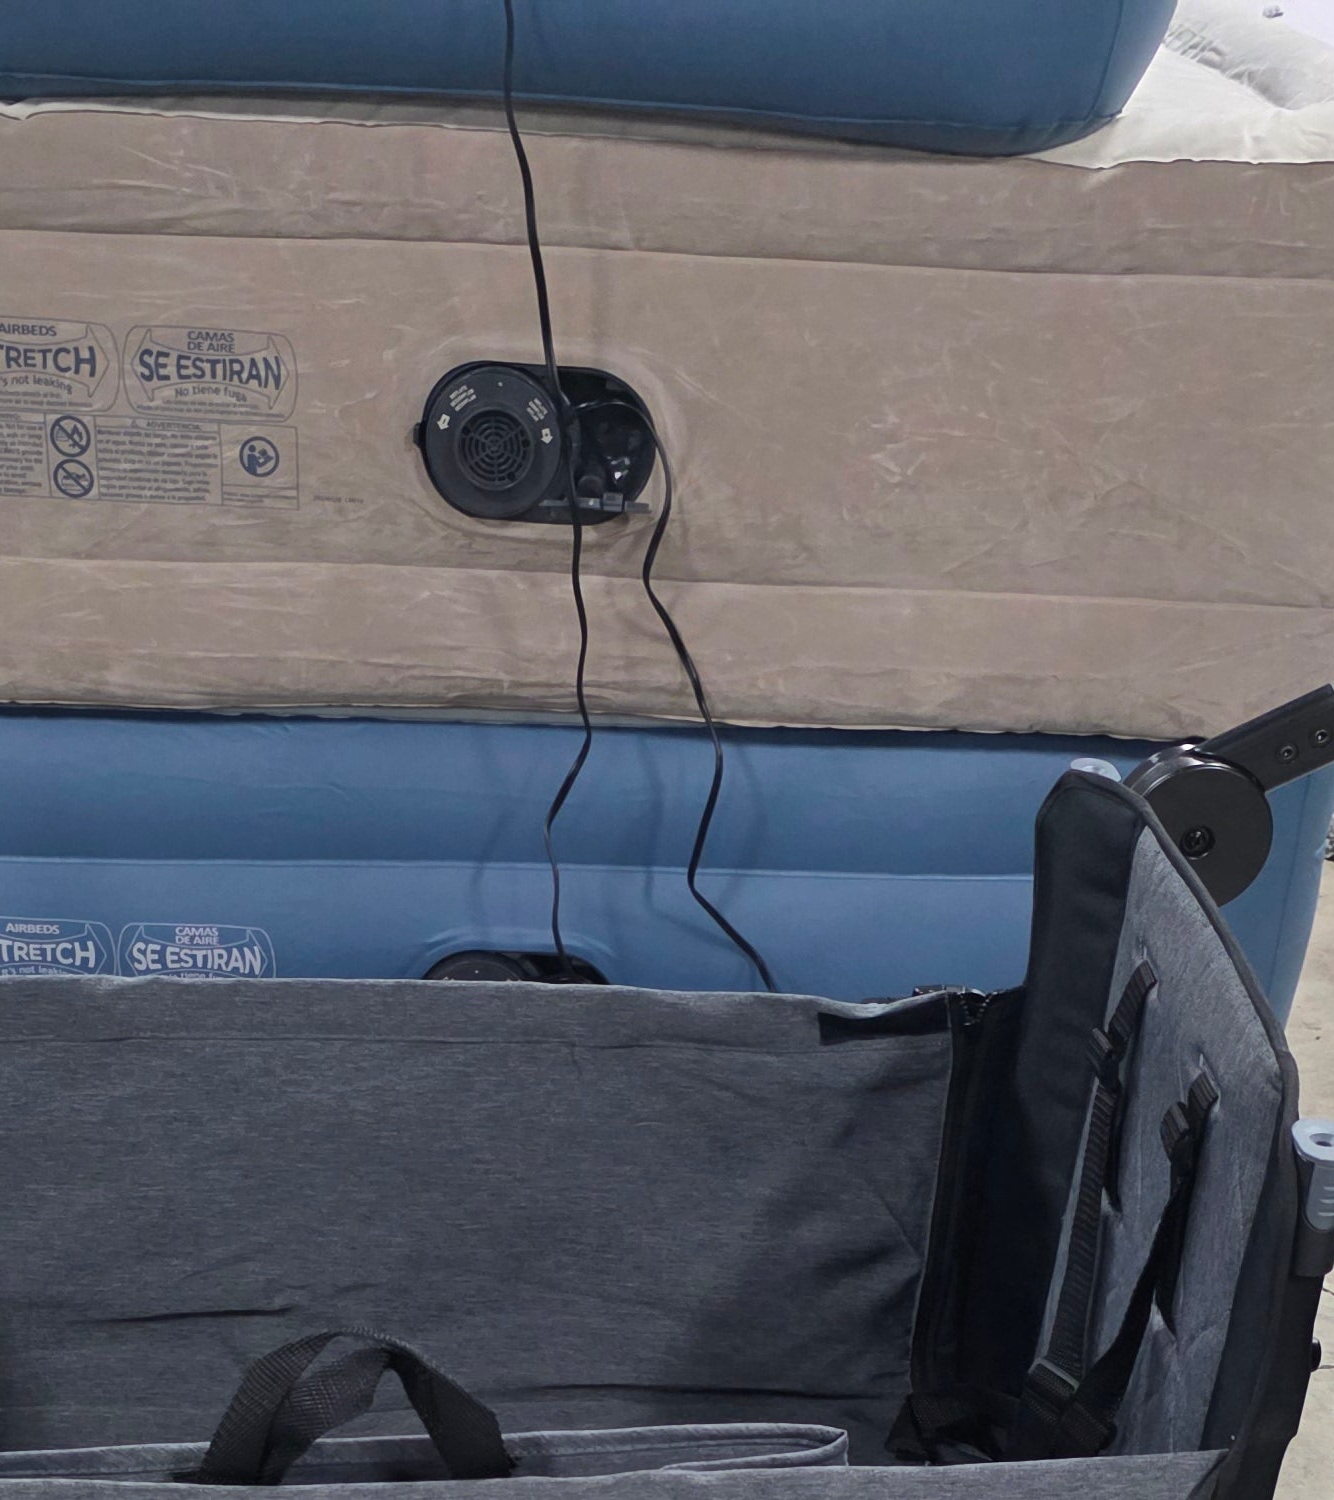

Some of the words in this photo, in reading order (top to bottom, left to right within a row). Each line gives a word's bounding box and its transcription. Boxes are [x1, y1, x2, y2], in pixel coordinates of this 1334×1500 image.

[187, 330, 235, 342] CAMAS
[187, 341, 203, 351] DE
[207, 343, 235, 353] AIRE
[139, 349, 170, 382] SE
[176, 354, 281, 390] ESTIRAN
[11, 375, 30, 385] not
[33, 375, 73, 395] leaking
[174, 388, 189, 399] No
[192, 386, 221, 395] tiene
[224, 387, 247, 402] fuga
[5, 922, 60, 935] AIRBEDS
[175, 926, 219, 936] CAMAS
[175, 935, 190, 944] DE
[193, 936, 219, 945] AIRE
[132, 941, 162, 971] SE
[166, 945, 262, 976] ESTIRAN
[18, 966, 35, 974] not
